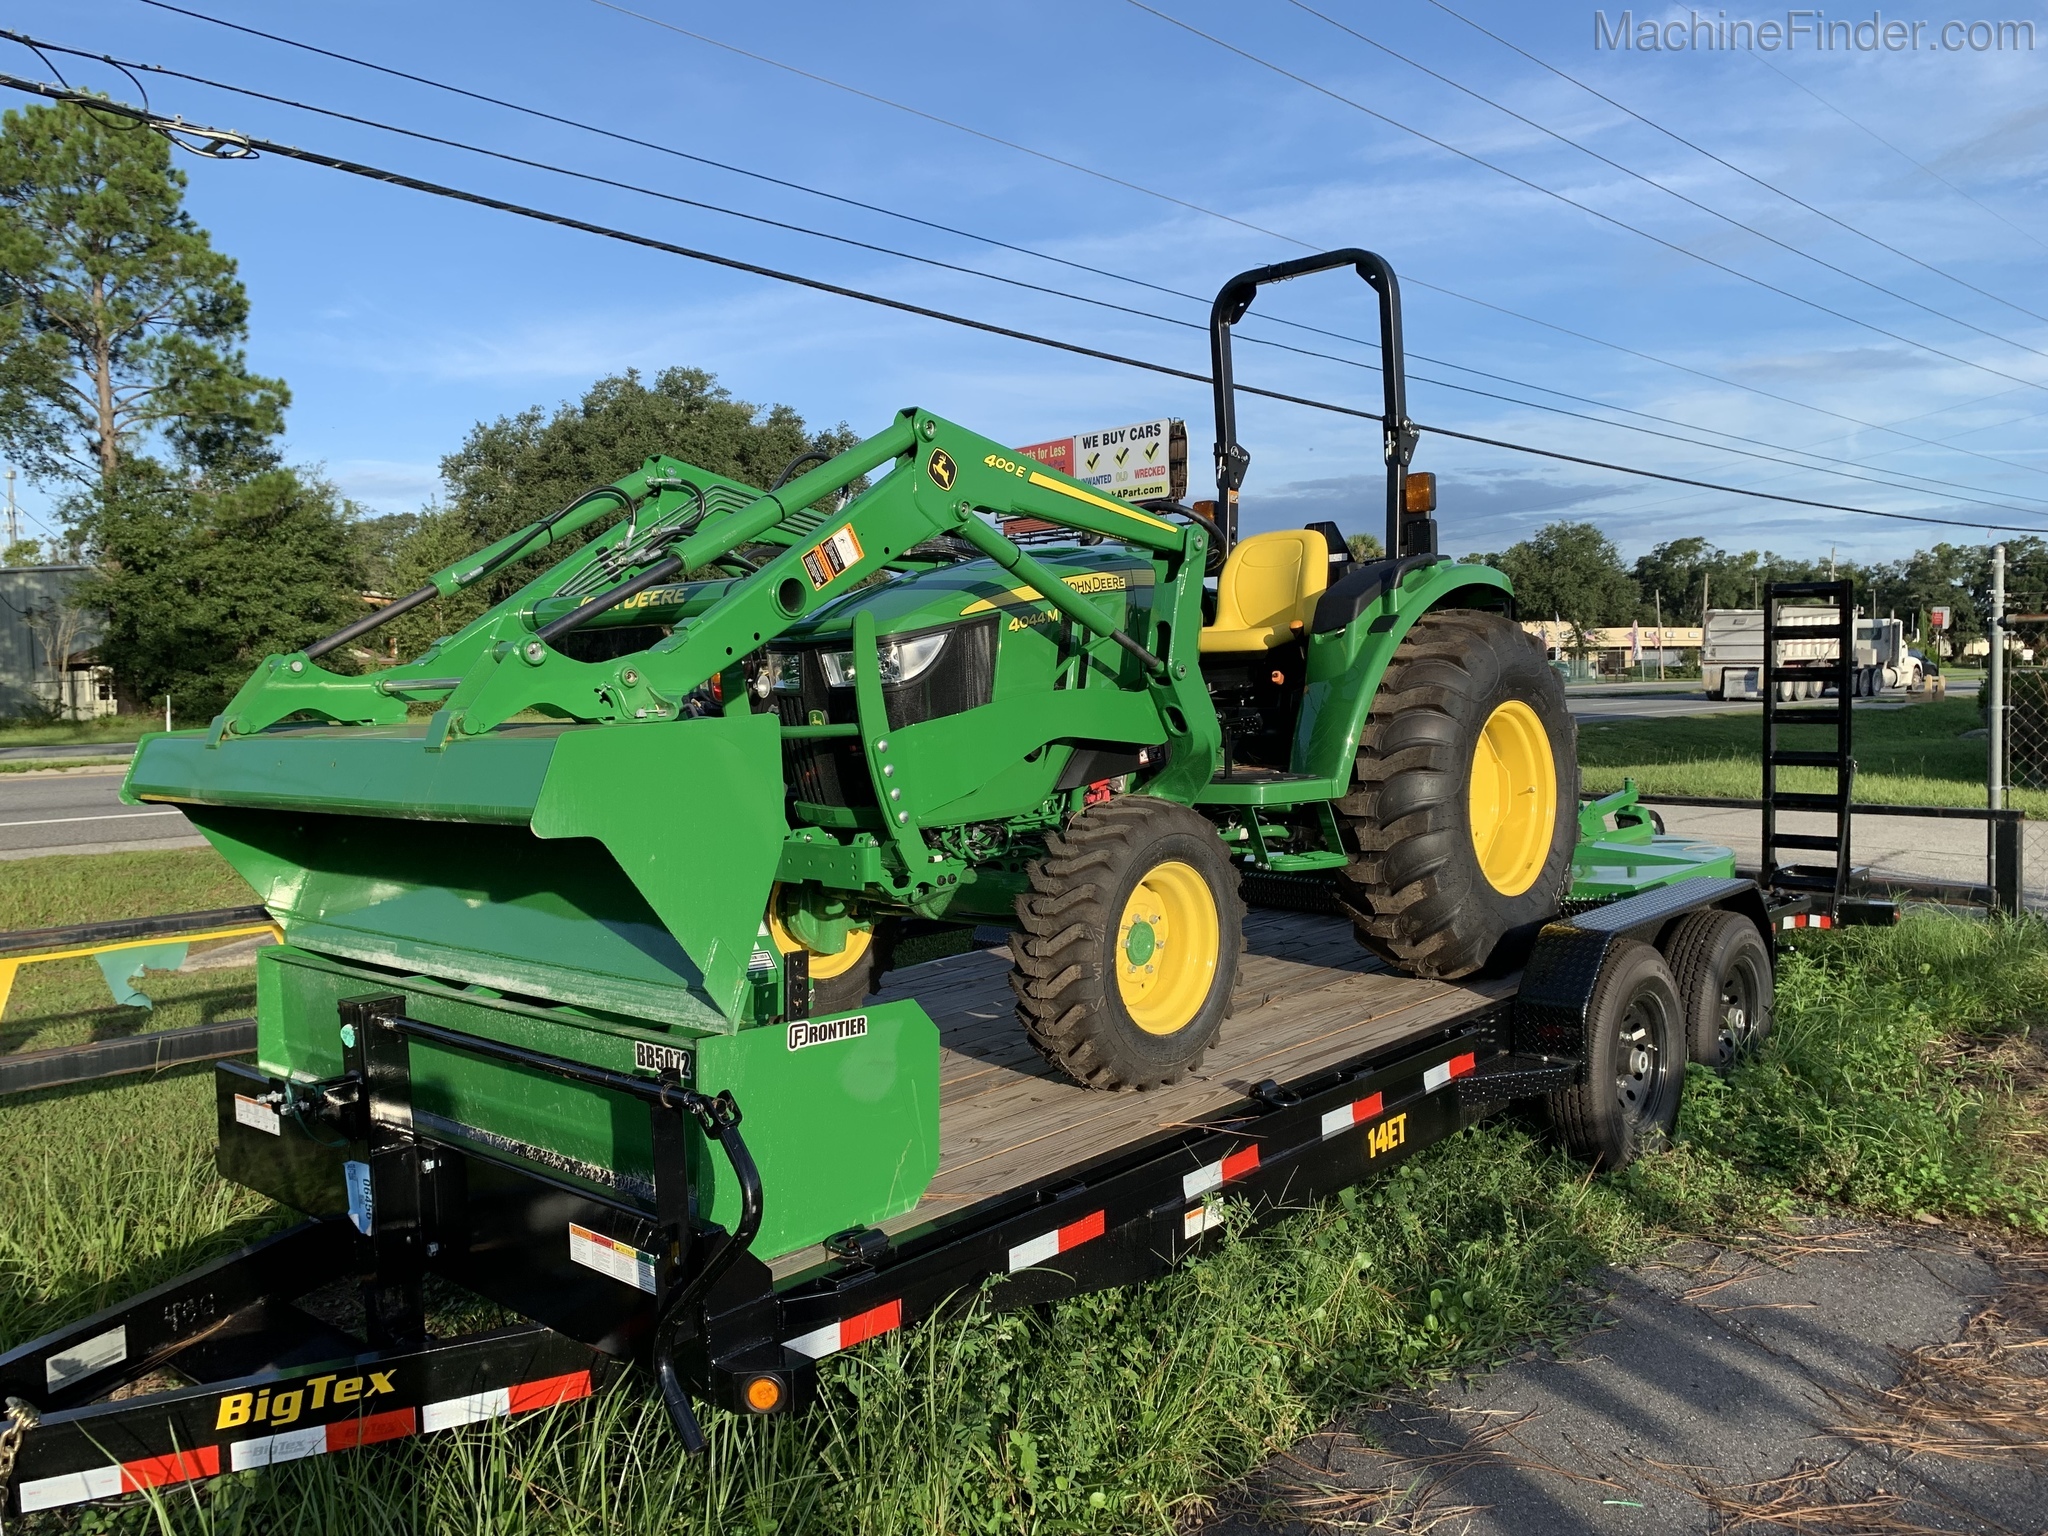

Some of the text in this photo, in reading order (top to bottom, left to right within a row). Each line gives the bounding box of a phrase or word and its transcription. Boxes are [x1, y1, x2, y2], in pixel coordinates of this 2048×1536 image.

[1083, 423, 1161, 449] WE BUY CARS
[1038, 448, 1048, 460] for
[1050, 445, 1066, 458] Less
[983, 454, 1027, 478] 400 E
[1079, 465, 1166, 485] NWANTED OLD WRECKED
[1092, 577, 1124, 590] DEERE
[1008, 608, 1058, 632] 4044 M
[789, 1017, 866, 1049] FRONTIER
[636, 1042, 691, 1077] BB5072
[1367, 1113, 1407, 1159] 14ET
[215, 1368, 397, 1430] BigTex
[253, 1440, 304, 1456] BigTex
